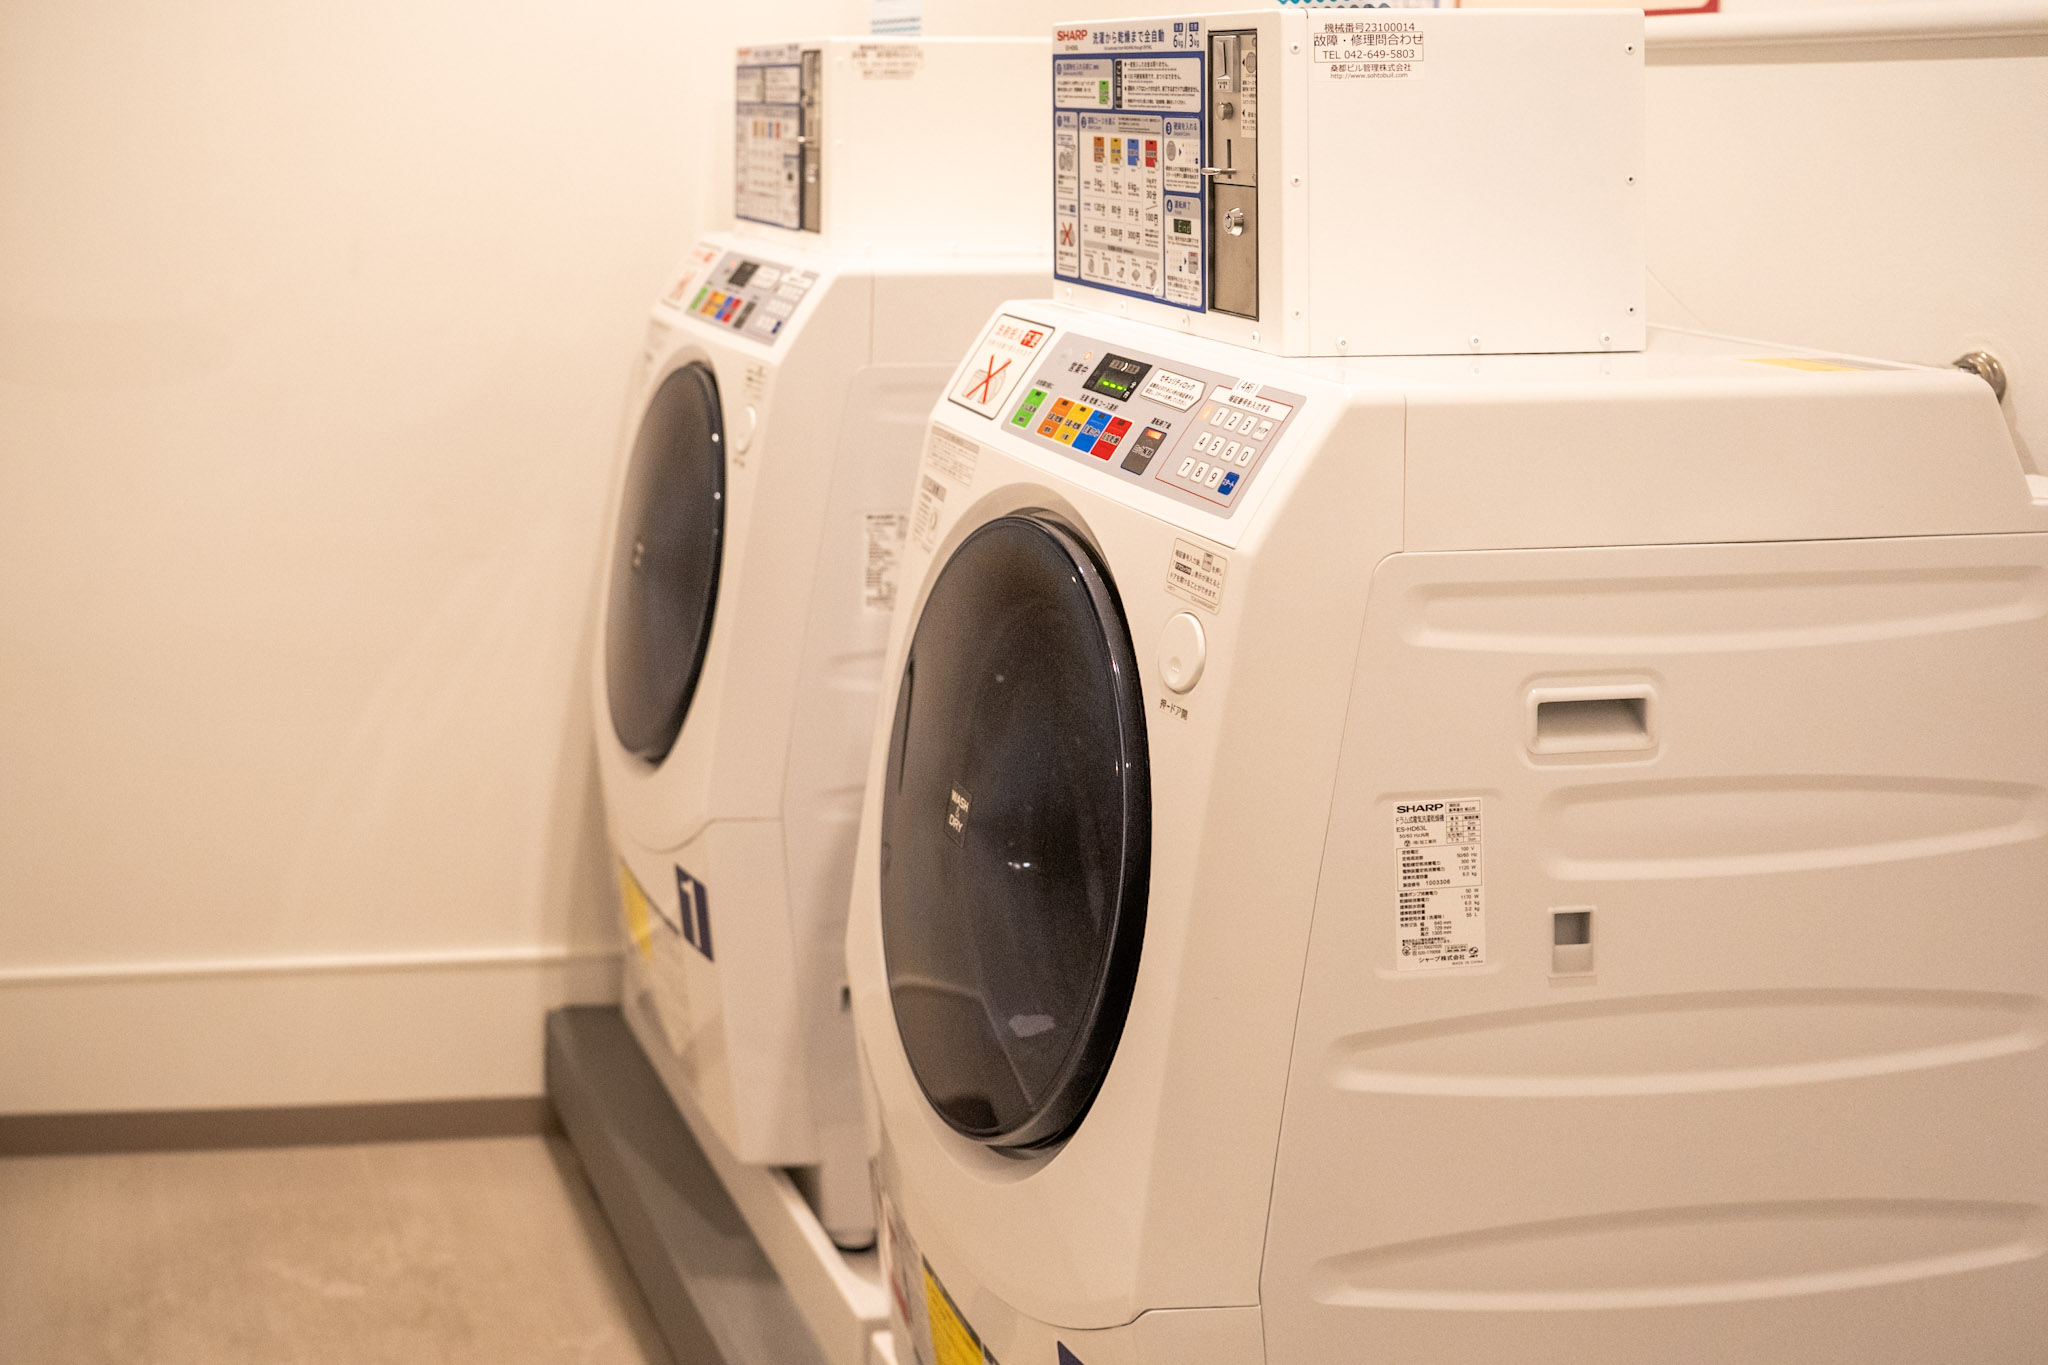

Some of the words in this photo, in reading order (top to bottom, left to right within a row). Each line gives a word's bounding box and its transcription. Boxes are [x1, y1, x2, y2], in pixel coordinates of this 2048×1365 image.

[1324, 22, 1415, 33] 機械番号23100014
[1057, 29, 1088, 42] SHARP
[1093, 29, 1165, 45] 洗濯から乾燥まで全自動
[1314, 34, 1423, 46] 故障・修理問合わせ
[1322, 50, 1341, 60] TEL
[1344, 49, 1415, 59] 042-649-5803
[1330, 63, 1412, 72] 桑都ビル管理株式会社
[1177, 221, 1191, 234] End
[1215, 412, 1222, 421] 1
[1228, 416, 1237, 427] 2
[1243, 420, 1251, 431] 3
[1198, 437, 1205, 446] 4
[1211, 441, 1218, 451] 5
[1226, 445, 1233, 456] 6
[1241, 450, 1249, 462] 0
[1182, 462, 1190, 472] 7
[1195, 467, 1202, 477] 8
[1210, 472, 1218, 483] 9
[951, 789, 969, 813] WASH
[1397, 803, 1444, 814] SHARP
[949, 813, 964, 833] DRY
[1396, 814, 1444, 824] ドラム式電気洗濯乾燥機
[680, 878, 703, 949] 1
[1419, 954, 1465, 963] シャープ株式会社
